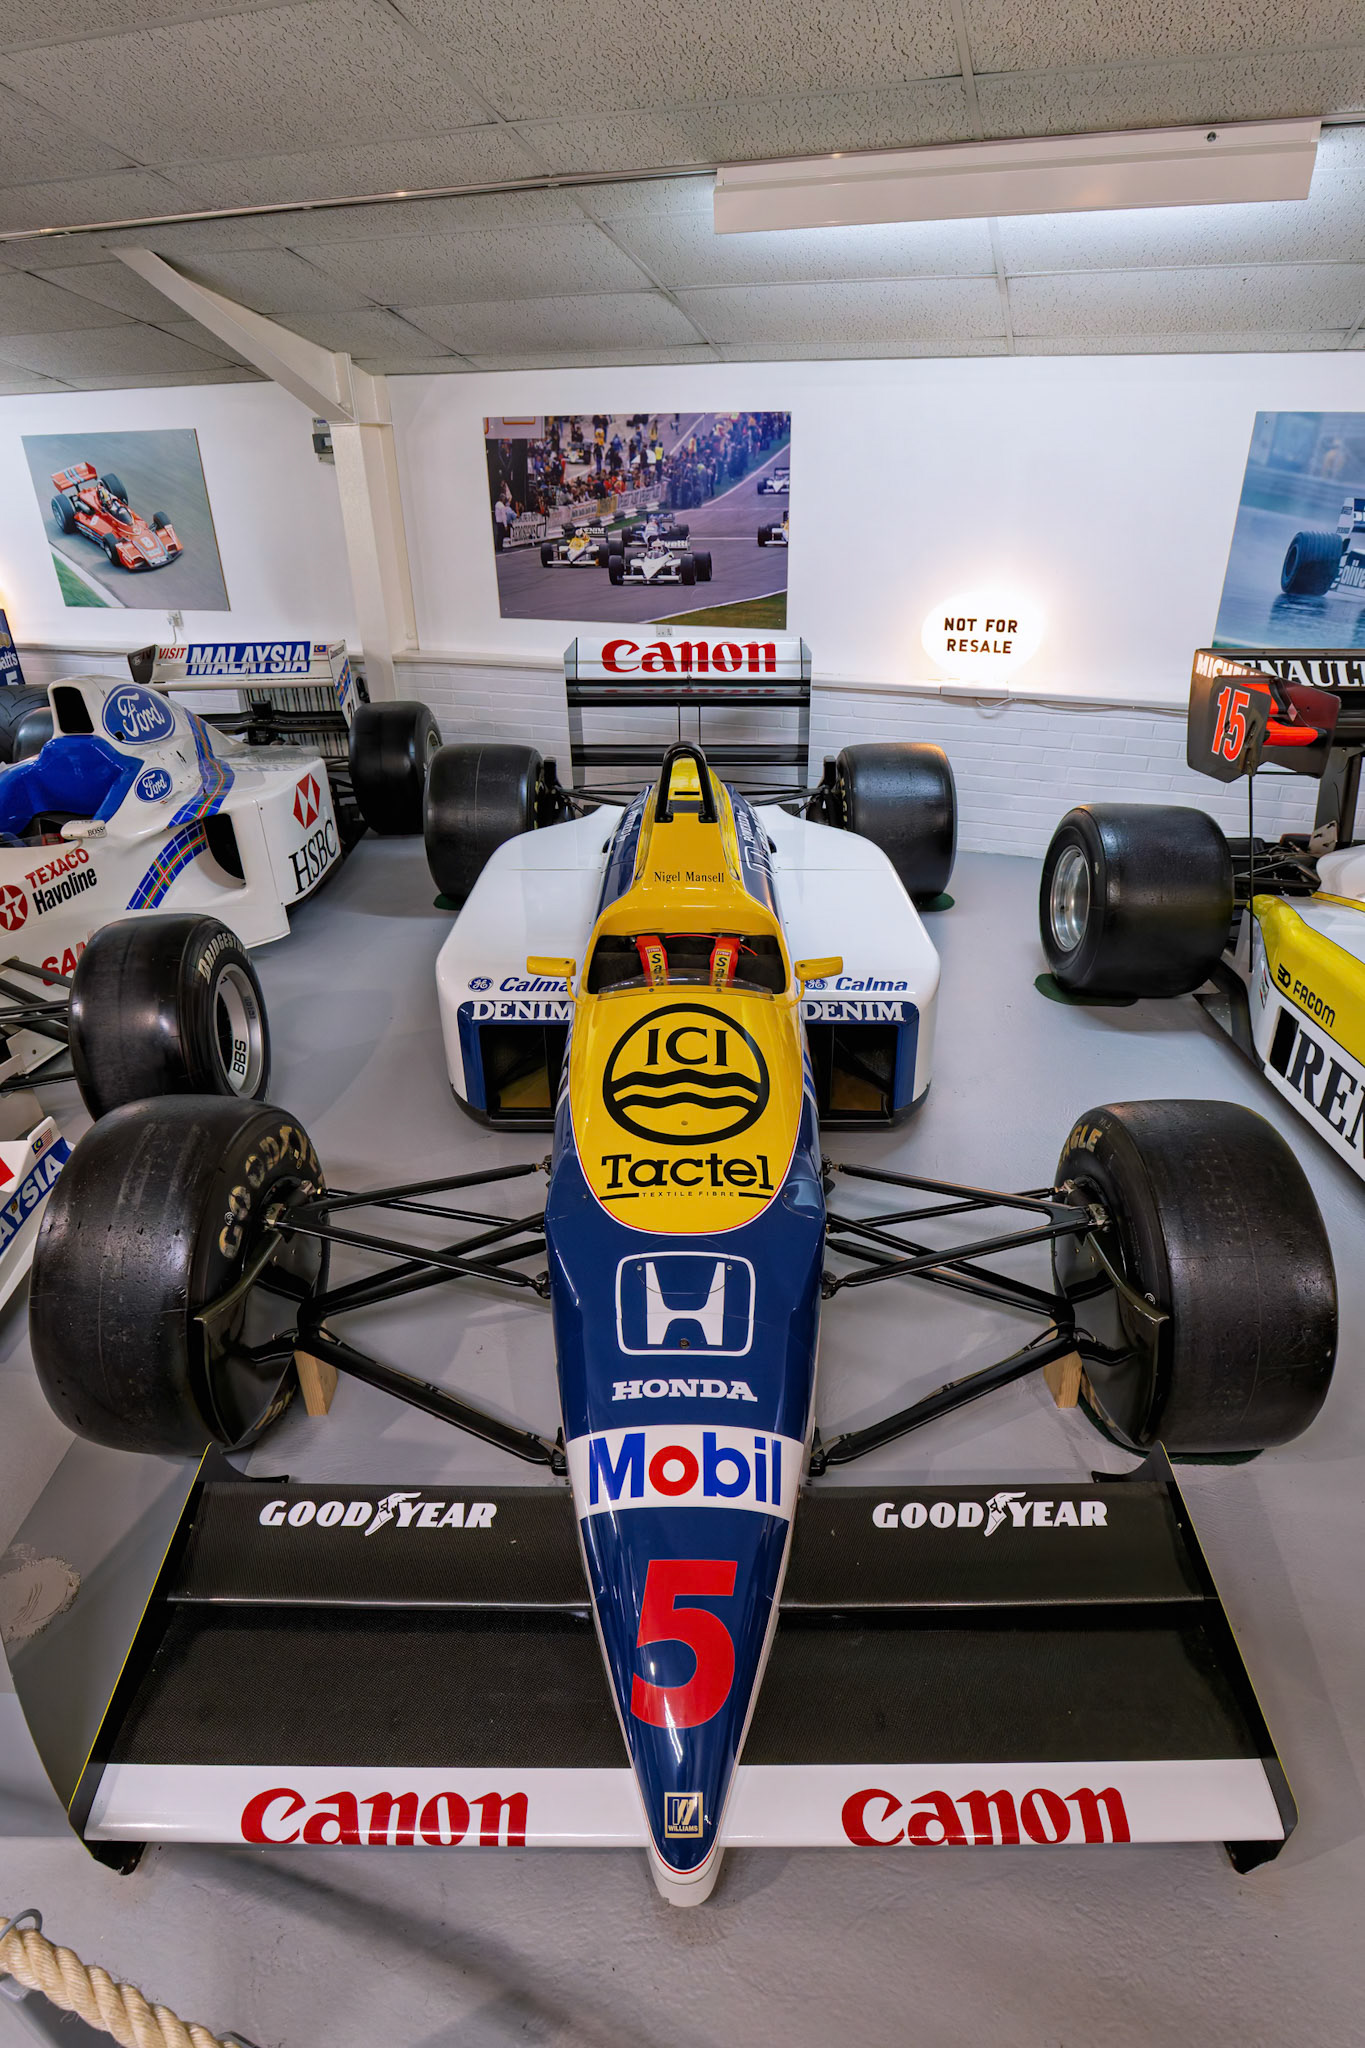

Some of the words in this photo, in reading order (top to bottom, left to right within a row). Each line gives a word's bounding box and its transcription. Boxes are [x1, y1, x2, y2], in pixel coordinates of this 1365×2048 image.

[944, 617, 977, 631] NOT
[986, 619, 1018, 633] FOR
[158, 647, 187, 660] VISIT
[189, 644, 308, 675] MALAYSIA
[601, 639, 776, 673] Canon
[947, 638, 1012, 654] RESALE
[118, 692, 165, 738] Ford
[1211, 686, 1251, 761] 15
[142, 773, 167, 798] Ford
[25, 848, 89, 889] TEXACO
[288, 818, 337, 895] HSBC
[32, 868, 97, 915] Havoline
[654, 871, 681, 883] Nigel
[685, 872, 725, 883] Mansell
[500, 977, 574, 992] Calma
[835, 977, 908, 992] Calma
[472, 1001, 576, 1020] DENIM
[802, 1001, 905, 1021] DENIM
[1293, 979, 1336, 1028] FACOM
[233, 1039, 247, 1076] BBS
[644, 1026, 729, 1066] ICI
[1058, 1125, 1103, 1172] AGLE
[601, 1153, 775, 1190] Tactel
[611, 1379, 758, 1402] HONDA
[588, 1432, 782, 1506] Mobil
[630, 1559, 738, 1729] 5
[240, 1787, 529, 1847] Canon
[841, 1787, 1131, 1847] Canon
